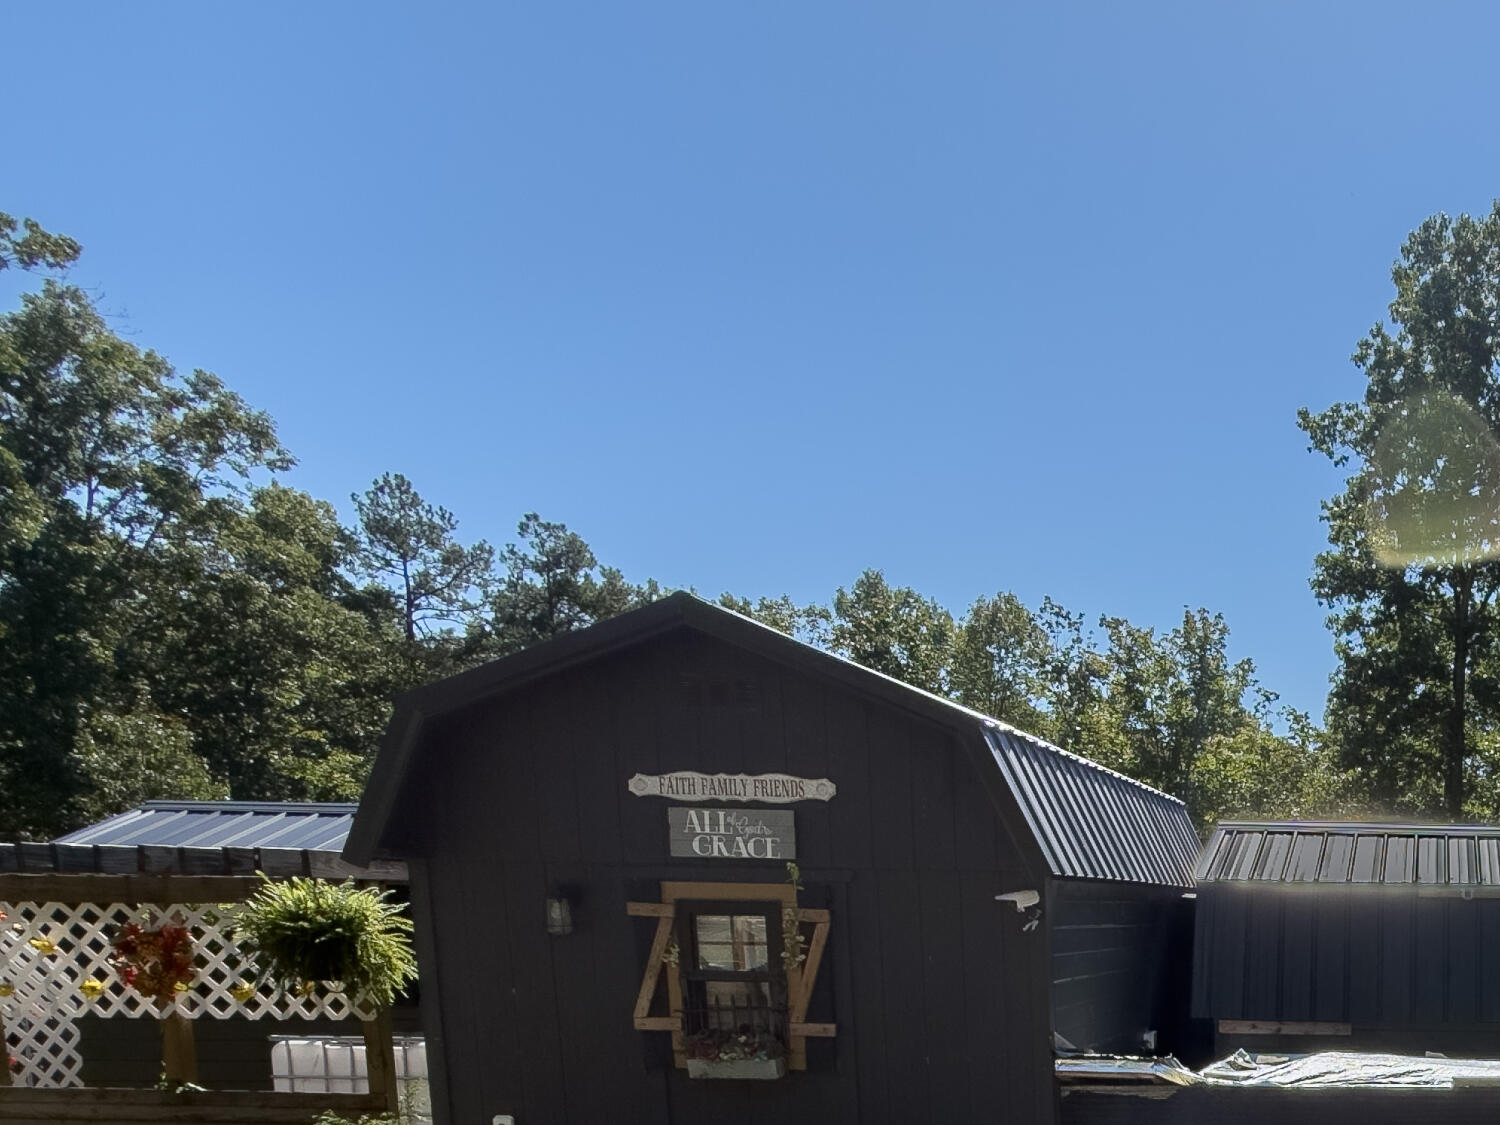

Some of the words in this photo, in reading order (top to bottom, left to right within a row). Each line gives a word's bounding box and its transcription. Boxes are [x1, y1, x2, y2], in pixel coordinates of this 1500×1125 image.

[658, 775, 696, 796] FAITH
[701, 777, 750, 798] FAMILY
[753, 778, 806, 799] FRIENDS
[684, 810, 733, 835] ALL
[692, 834, 781, 859] GRACE
